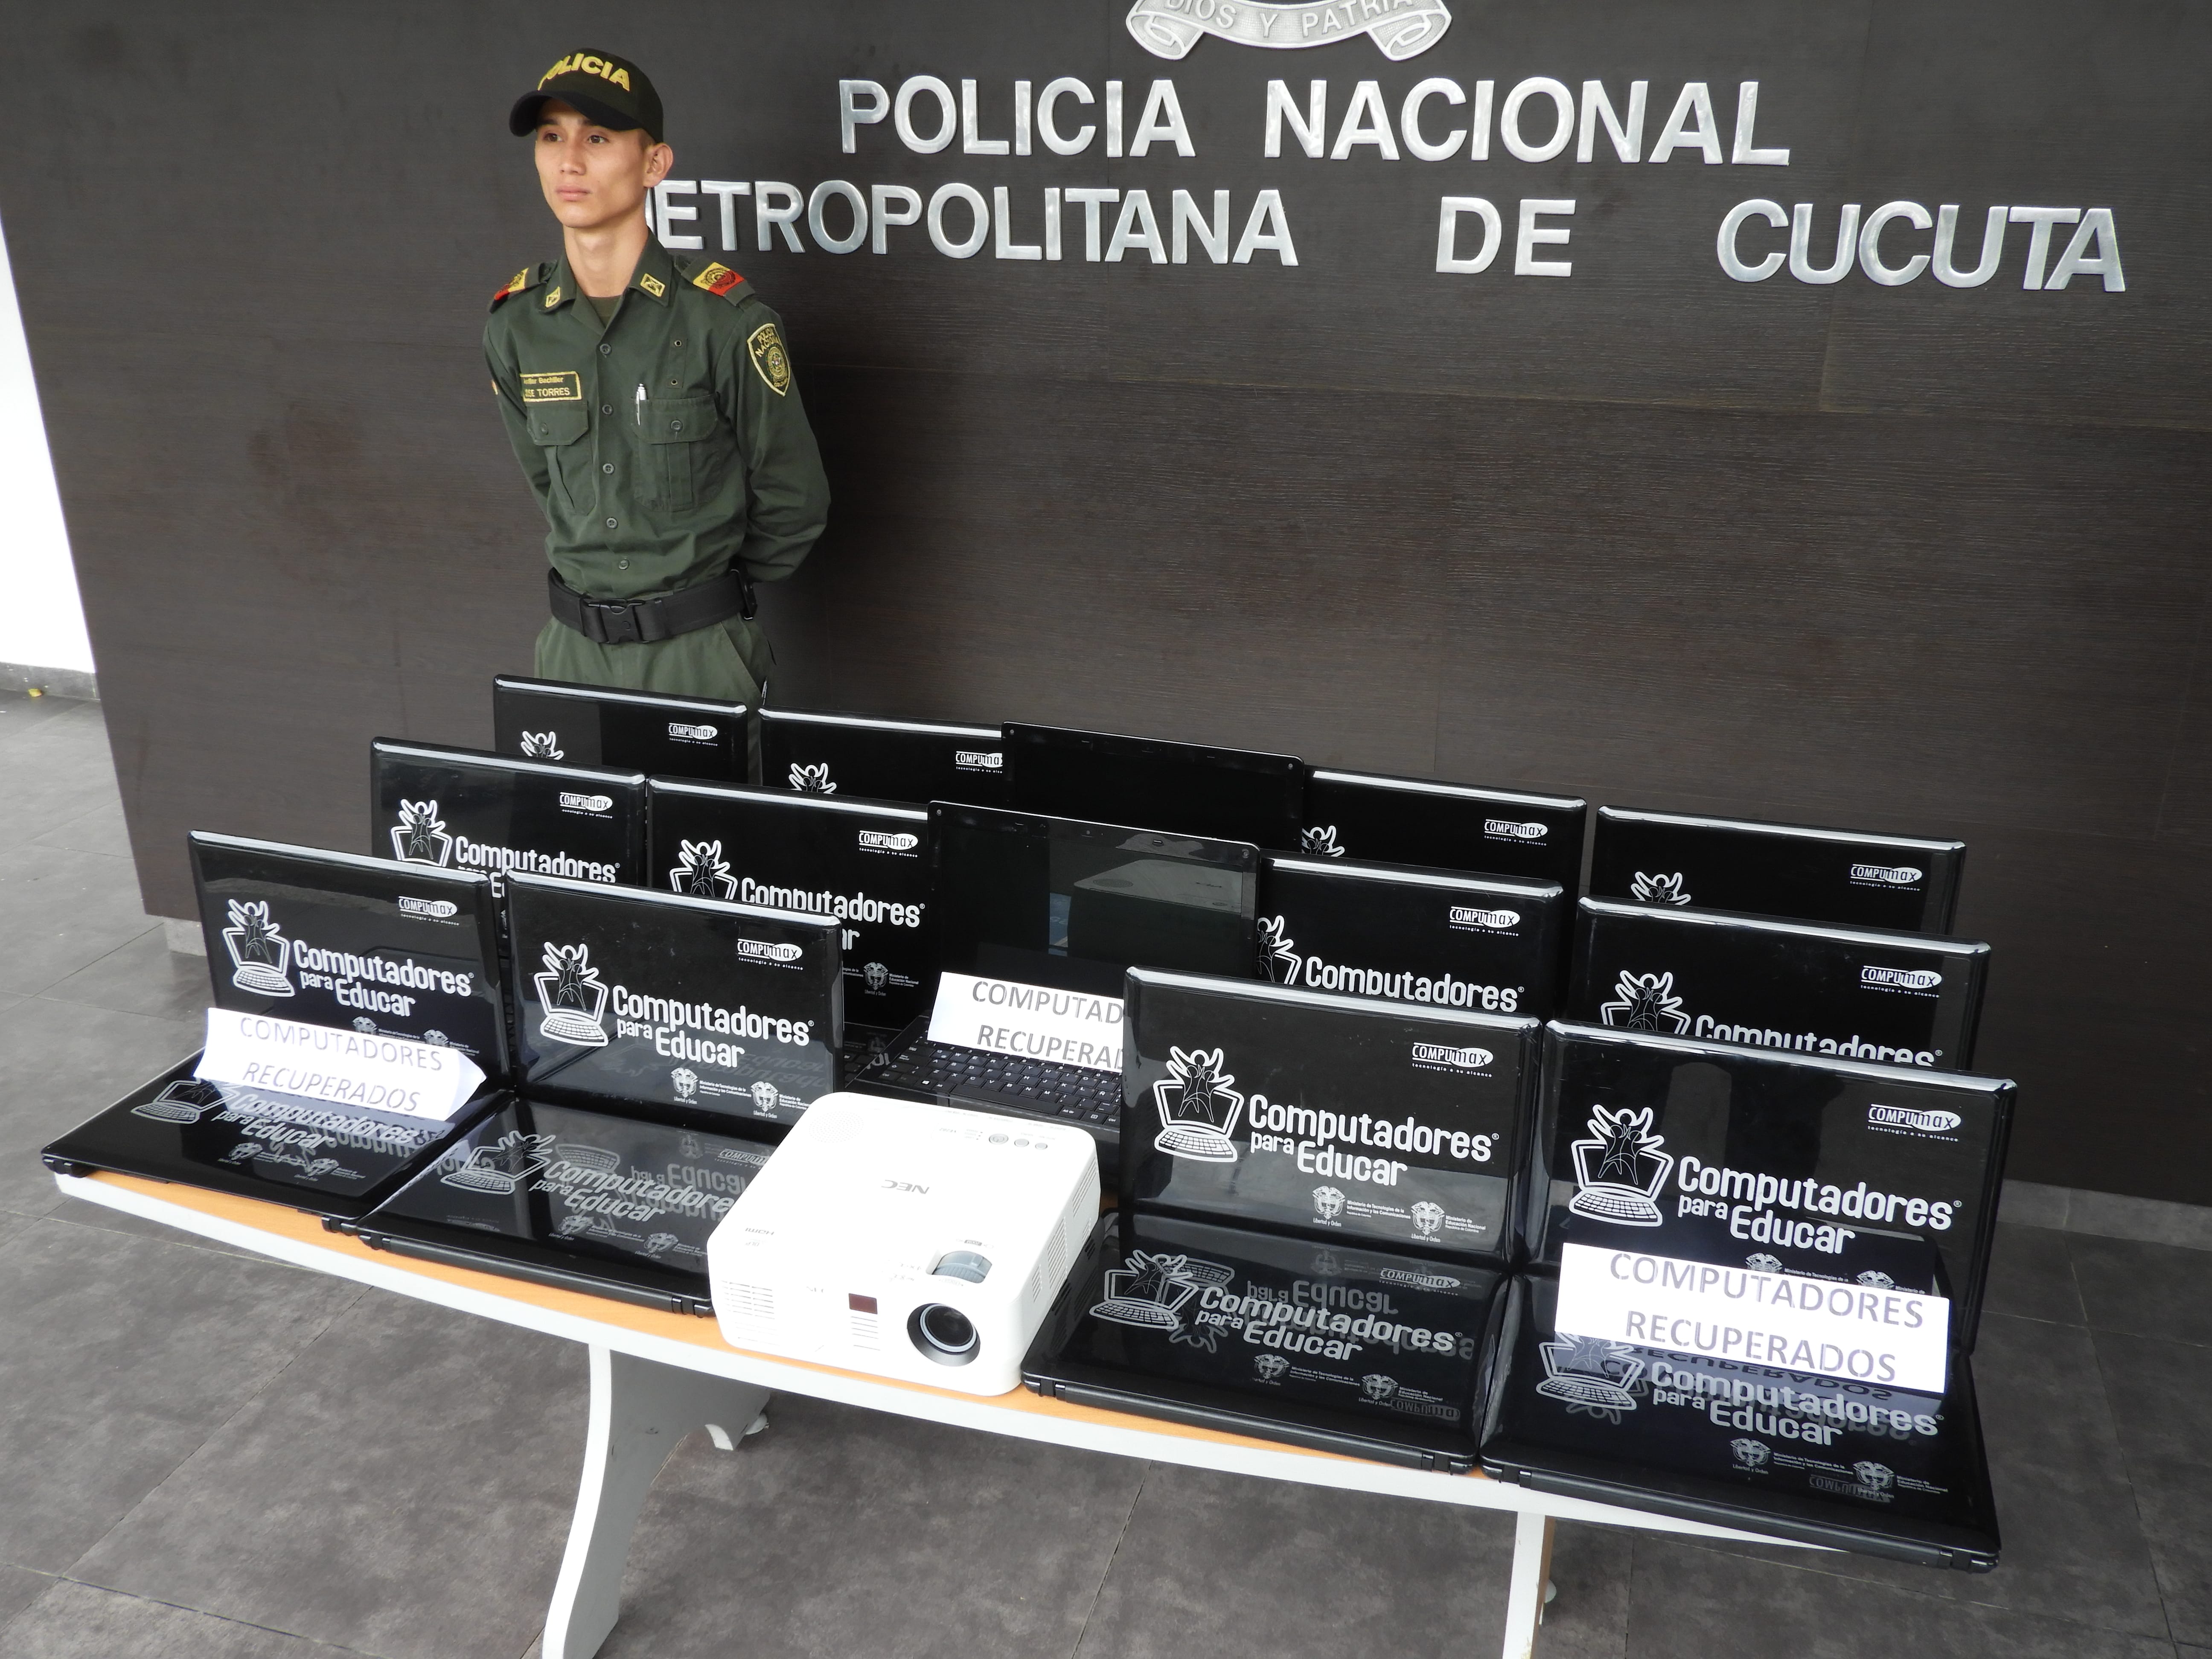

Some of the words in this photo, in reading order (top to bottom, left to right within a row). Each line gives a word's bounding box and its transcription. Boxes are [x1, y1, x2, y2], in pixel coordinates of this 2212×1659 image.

[1260, 13, 1278, 38] Y
[839, 75, 1196, 157] POLICIA
[1264, 77, 1790, 166] NACIONAL
[646, 179, 1298, 267] ETROPOLITANA
[1435, 196, 1576, 276] DE
[1717, 198, 2126, 292] CUCUTA
[536, 387, 570, 397] TORRES
[956, 752, 1002, 767] COMPUma
[456, 835, 616, 883] Computadores
[742, 877, 920, 928] Computadores
[293, 939, 471, 997] Computadores
[299, 970, 333, 991] para
[335, 979, 416, 1017] Educar
[1306, 956, 1518, 1012] Computadores
[613, 985, 810, 1046] Computadores
[972, 981, 1123, 1024] COMPUTAD
[240, 1016, 443, 1072] COMPUTADORES
[616, 1018, 653, 1039] para
[654, 1027, 746, 1068] Educar
[977, 1025, 1123, 1070] RECUPERA
[242, 1061, 420, 1112] RECUPERADOS
[212, 1109, 251, 1126] para
[241, 1118, 336, 1149] Educar
[230, 1093, 414, 1144] Computadores
[1249, 1094, 1492, 1162] Computadores
[719, 1149, 769, 1165] COMPUm
[1250, 1131, 1295, 1155] para
[1296, 1141, 1408, 1186] Educar
[528, 1178, 573, 1196] para
[564, 1193, 666, 1222] Educar
[543, 1160, 734, 1214] Computadore
[881, 1179, 930, 1195] NEC
[1678, 1155, 1953, 1231] Computadores
[1313, 1217, 1327, 1225] Libertad
[1379, 1210, 1411, 1219] Comunicaciones
[1411, 1233, 1426, 1241] Libertad
[1446, 1215, 1466, 1223] Ministerio
[1678, 1194, 1728, 1220] para
[1729, 1205, 1856, 1254] Educar
[1609, 1252, 1924, 1329] COMPUTADORES
[1194, 1309, 1244, 1332] para
[1242, 1323, 1363, 1361] Educar
[1198, 1286, 1455, 1352] Computadores
[1625, 1310, 1897, 1382] RECUPERADOS
[1651, 1361, 1939, 1437] Computadores
[1653, 1385, 1706, 1410] para
[1709, 1399, 1843, 1446] Educar
